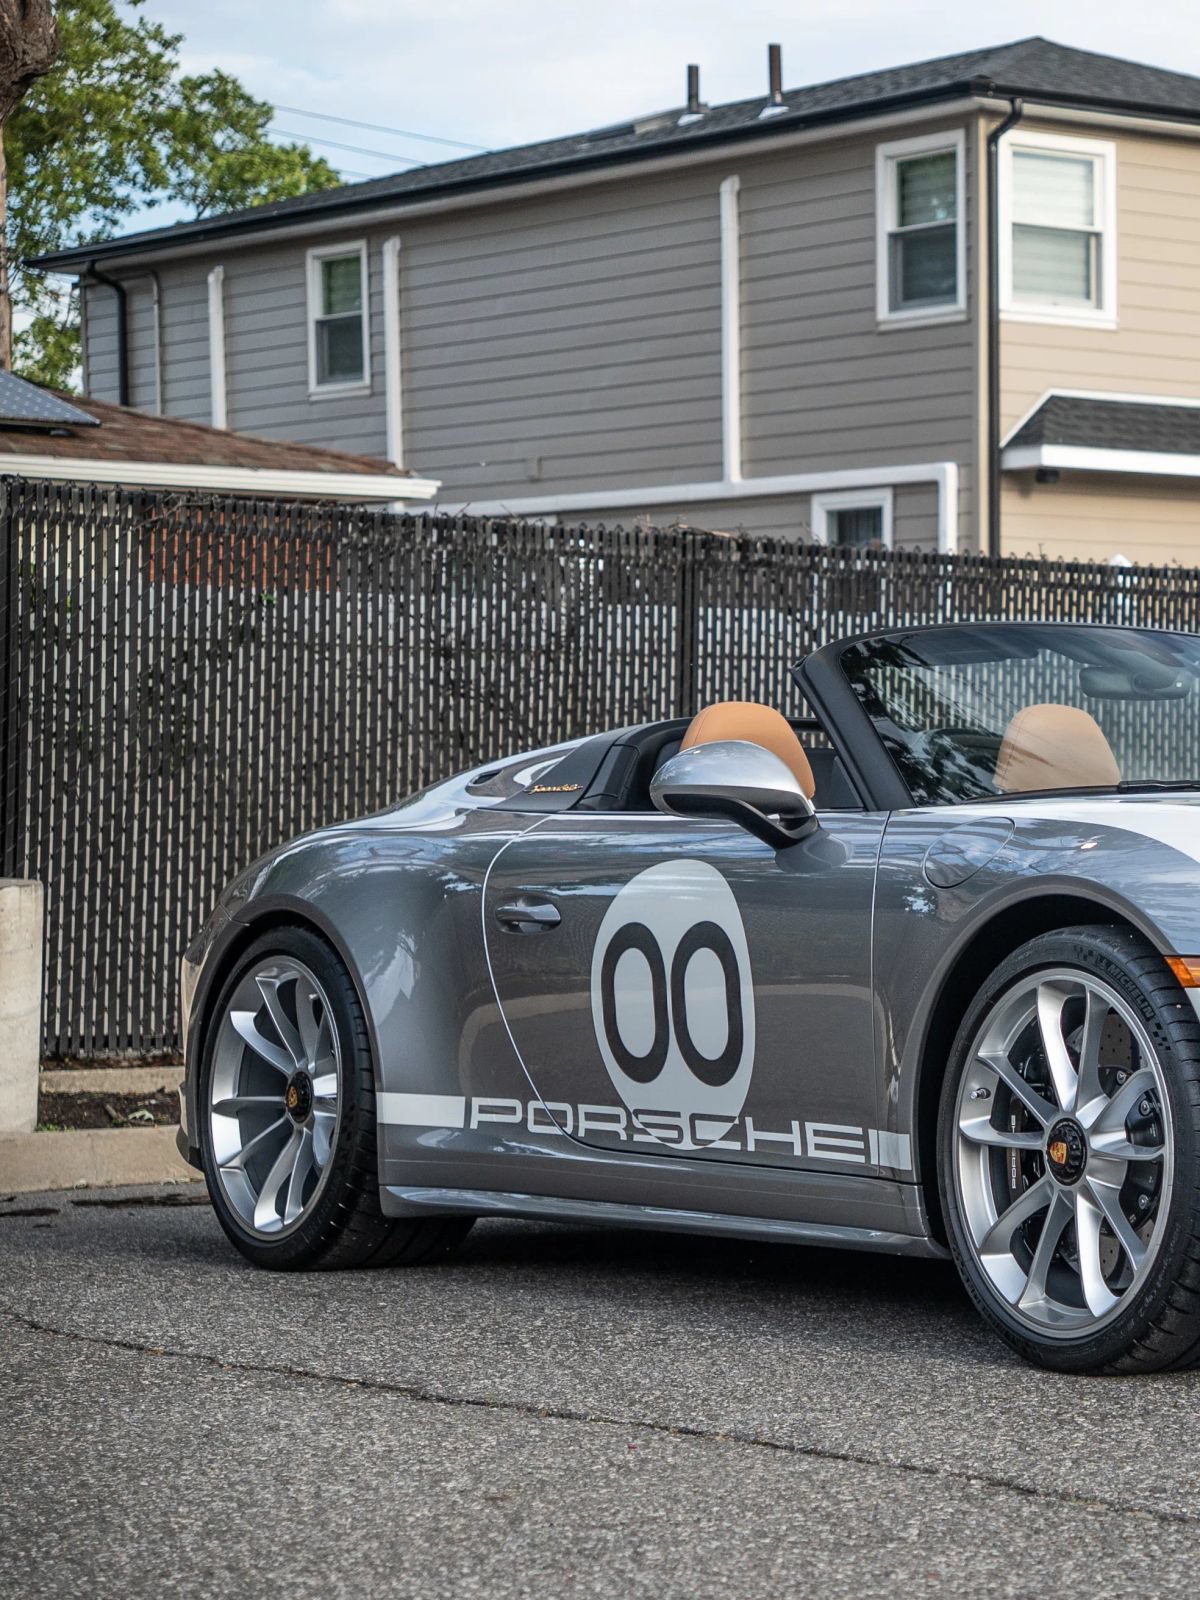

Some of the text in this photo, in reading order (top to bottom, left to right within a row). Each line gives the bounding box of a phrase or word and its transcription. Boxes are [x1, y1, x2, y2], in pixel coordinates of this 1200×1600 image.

[601, 920, 745, 1087] 00
[1107, 962, 1155, 1020] MICHELIN
[470, 1096, 865, 1163] PORSCHE
